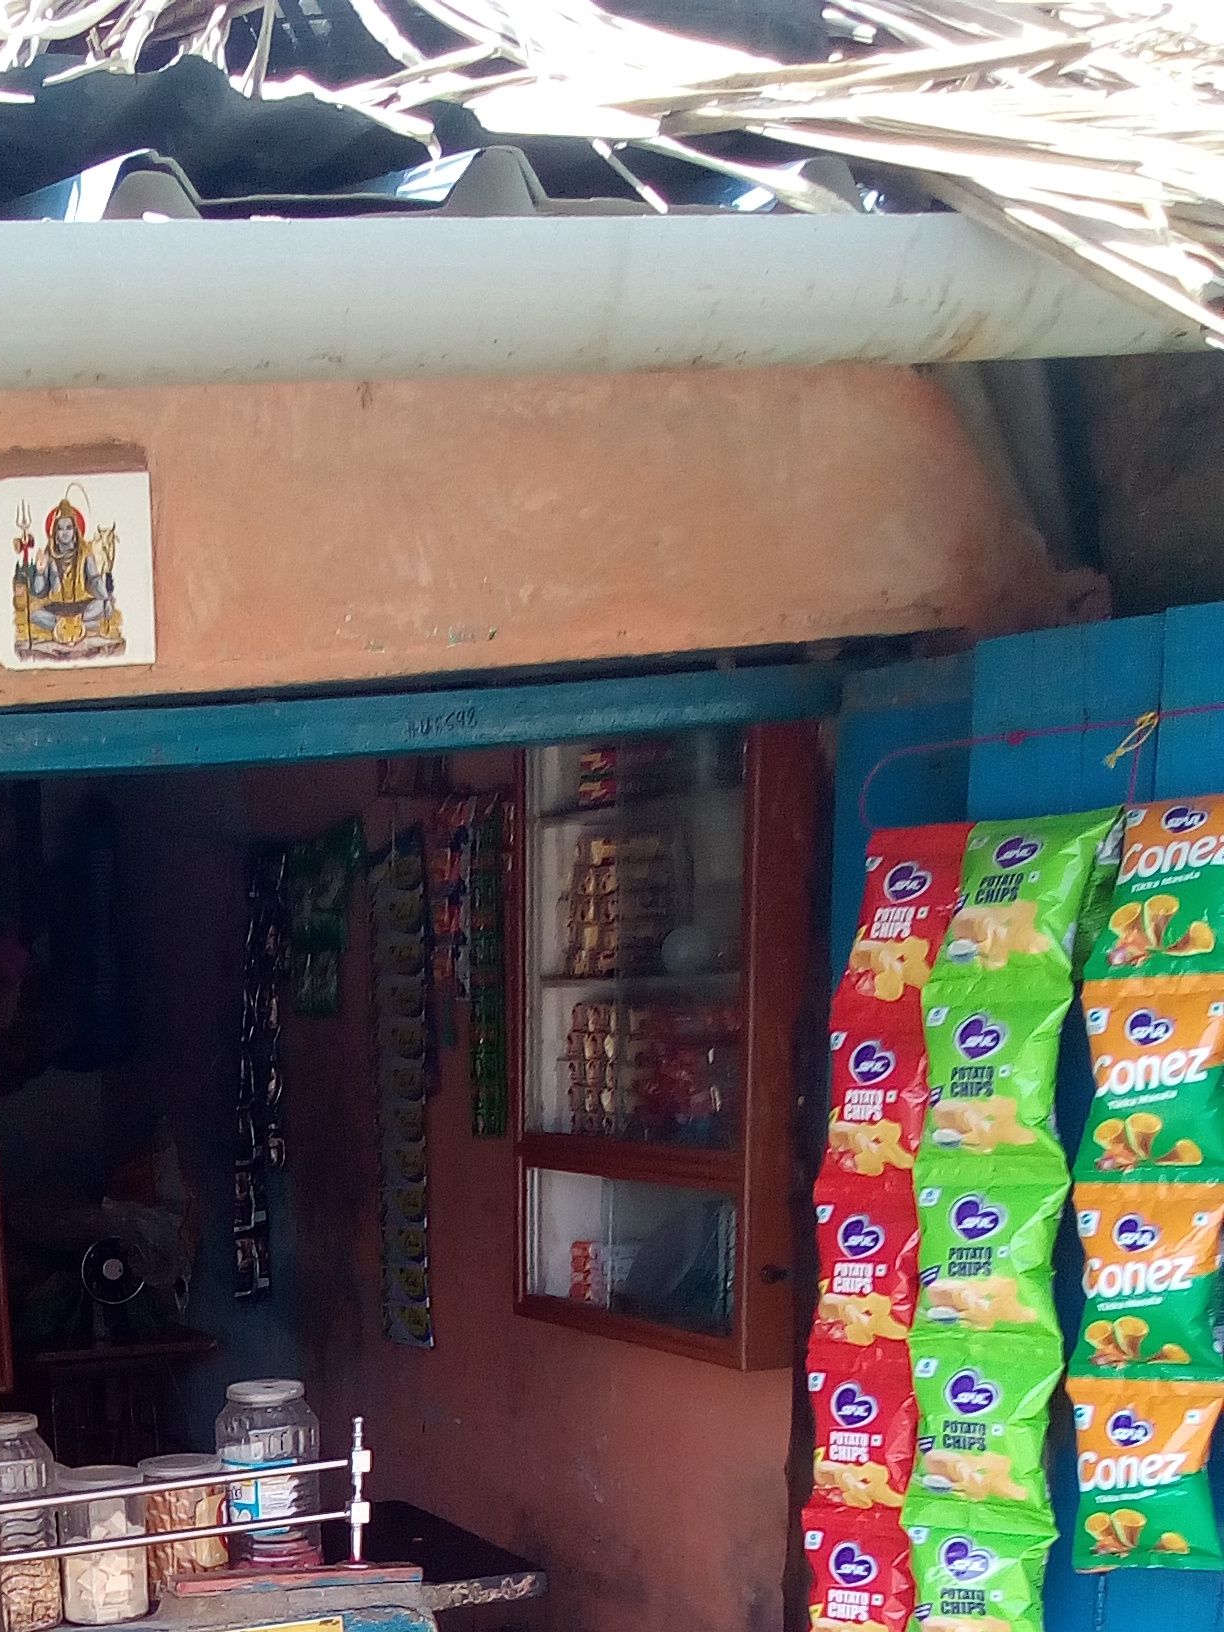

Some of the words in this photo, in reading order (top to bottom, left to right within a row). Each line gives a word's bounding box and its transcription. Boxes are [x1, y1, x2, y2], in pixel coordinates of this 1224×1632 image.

[976, 887, 1020, 904] CHIPS
[950, 1081, 994, 1097] CHIPS
[948, 1260, 992, 1277] CHIPS
[1082, 1255, 1195, 1299] Conez
[833, 1276, 873, 1293] CHIPS
[942, 1433, 986, 1451] CHIPS
[829, 1445, 869, 1462] CHIPS
[1077, 1451, 1188, 1493] Conez
[827, 1603, 869, 1620] CHIPS
[941, 1600, 986, 1615] CHIPS
